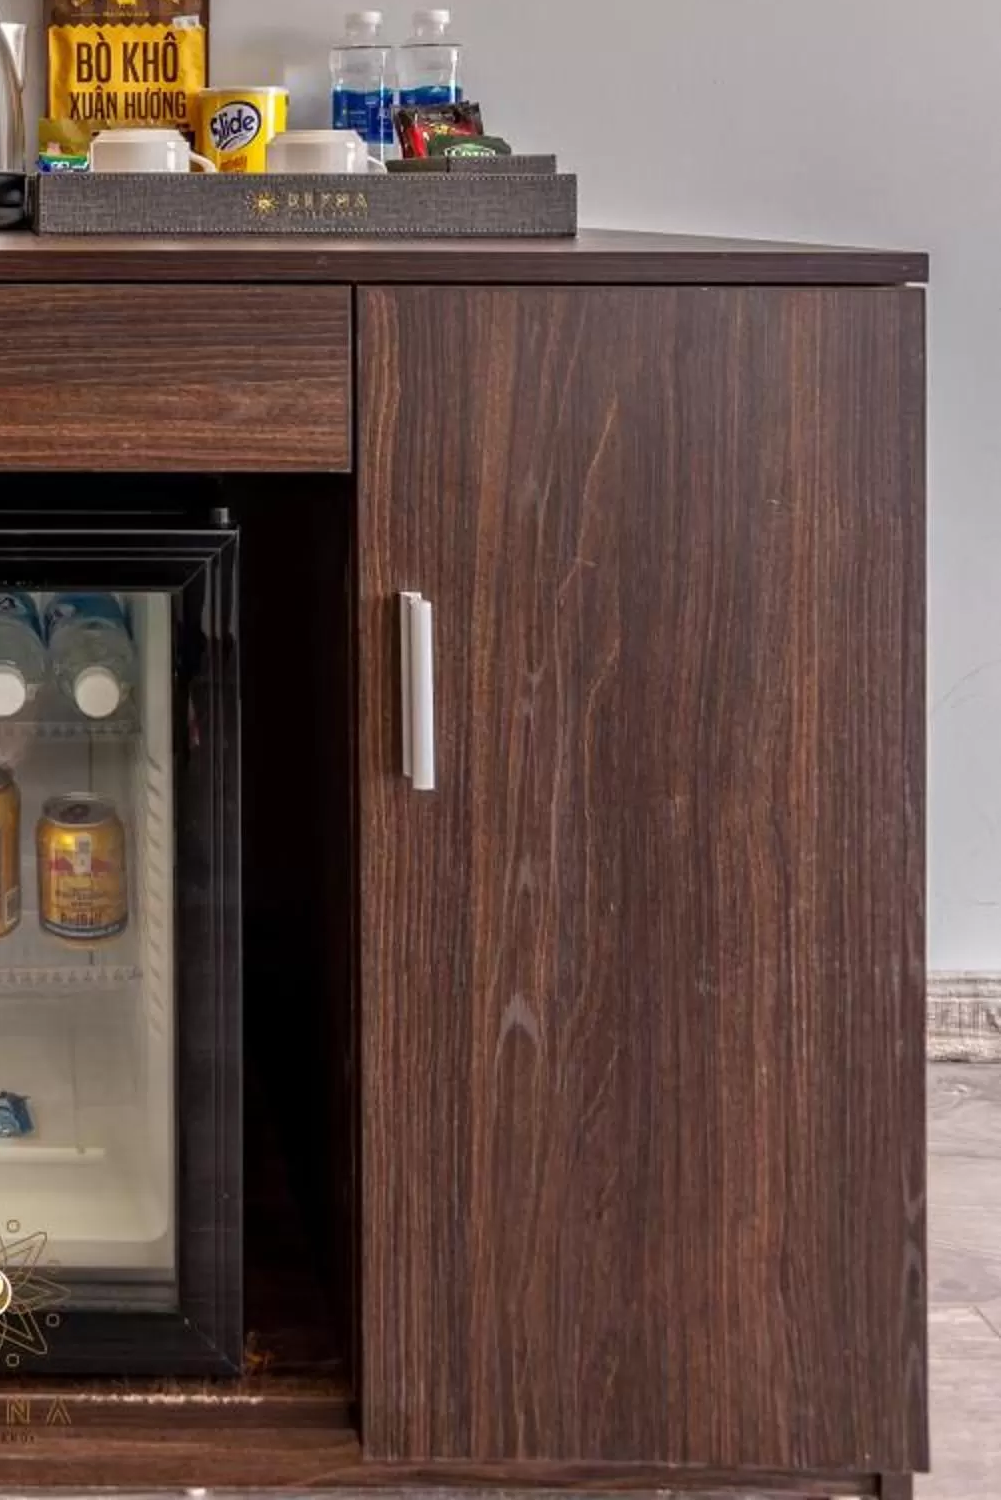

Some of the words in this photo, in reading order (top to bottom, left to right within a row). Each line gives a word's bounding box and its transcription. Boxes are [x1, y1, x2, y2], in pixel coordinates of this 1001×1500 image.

[76, 32, 112, 83] BÒ
[122, 32, 179, 83] KHÔ
[69, 85, 118, 120] XUÂN
[124, 87, 187, 119] HƯƠNG
